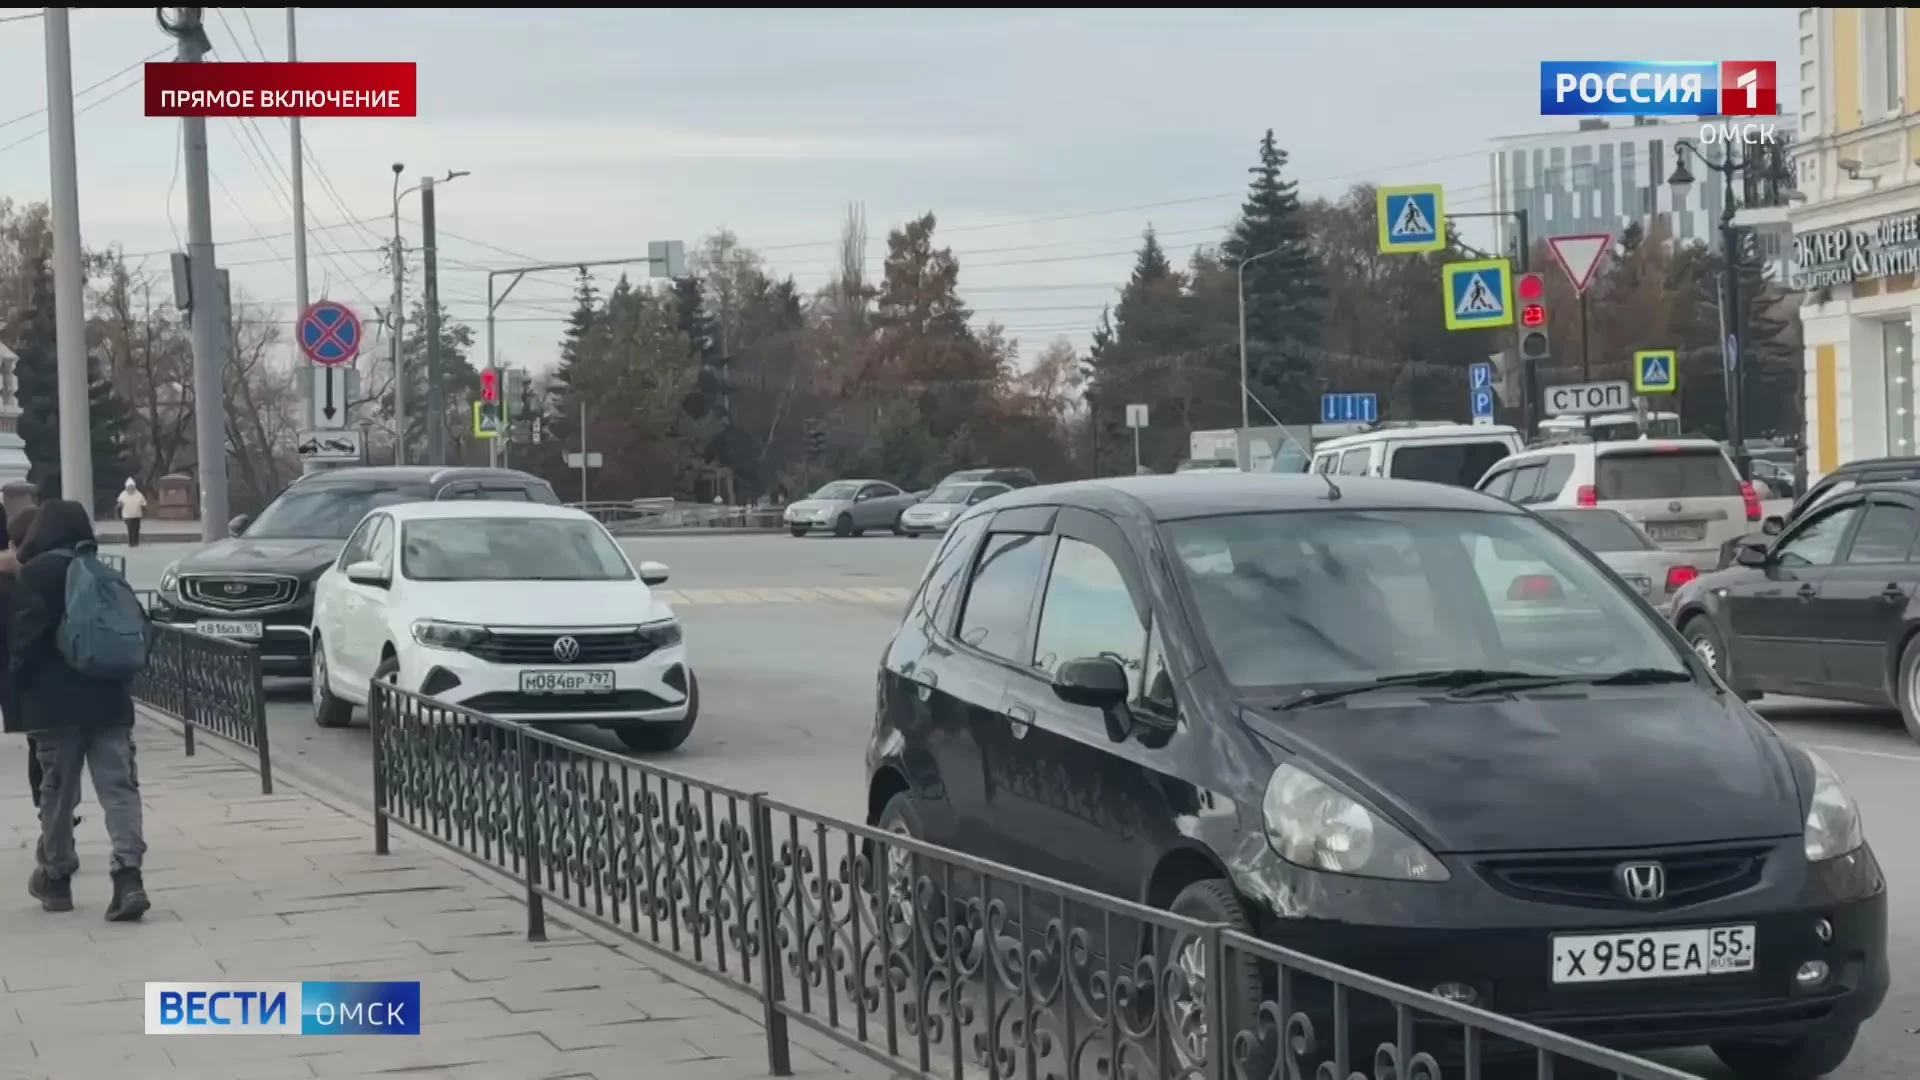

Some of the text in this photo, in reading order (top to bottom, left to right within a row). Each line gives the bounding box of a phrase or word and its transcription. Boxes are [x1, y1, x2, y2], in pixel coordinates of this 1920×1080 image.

[1876, 215, 1917, 247] COFFEE
[1792, 229, 1847, 268] ЭКЛЕР
[1871, 247, 1920, 277] ANYTIM
[1553, 385, 1622, 409] СТОП
[1567, 930, 1744, 977] Х958ЕА 55
